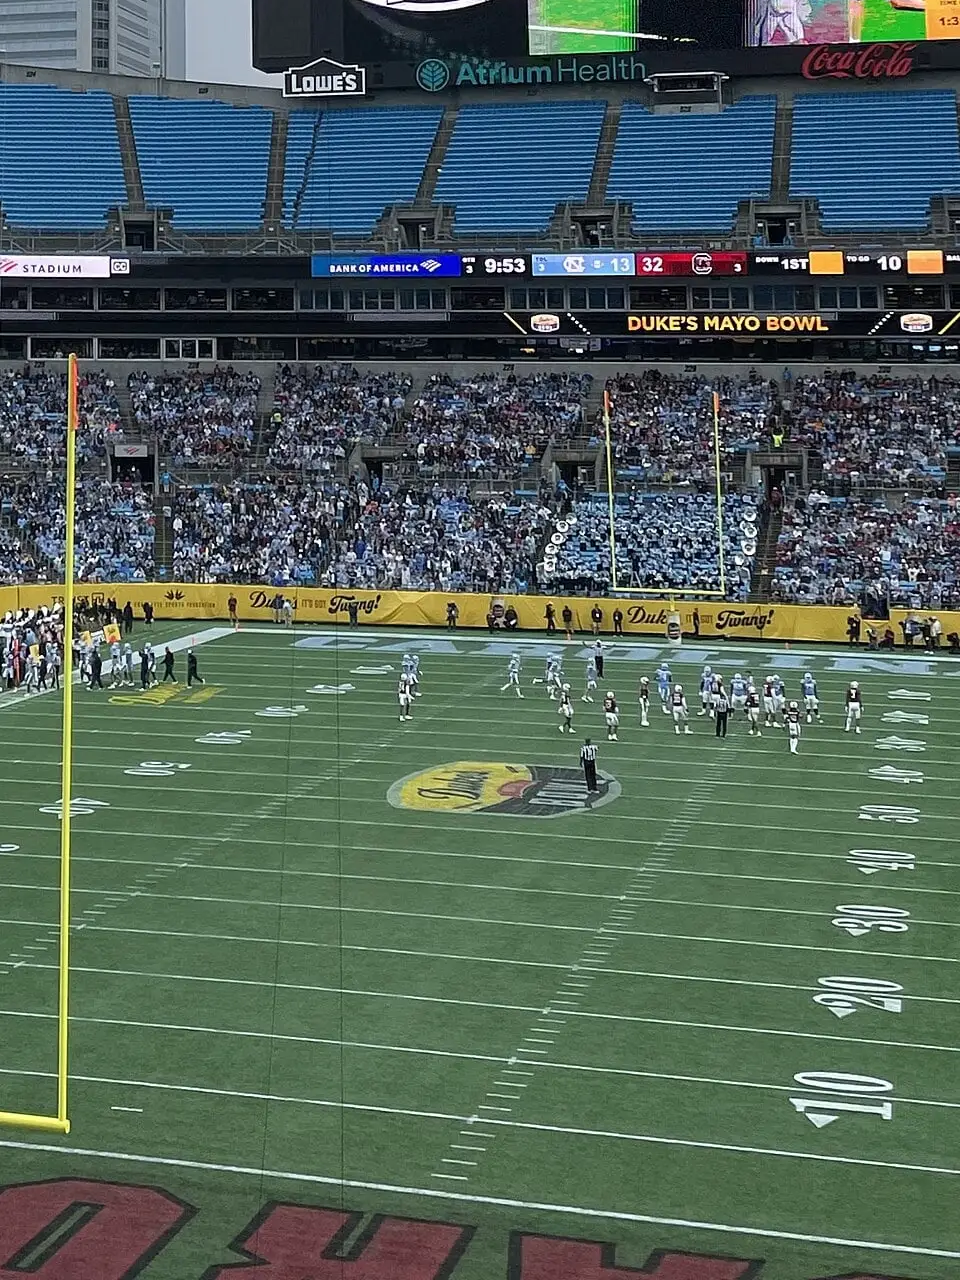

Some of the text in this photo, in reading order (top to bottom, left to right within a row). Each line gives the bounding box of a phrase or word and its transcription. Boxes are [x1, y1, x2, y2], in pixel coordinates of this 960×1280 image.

[455, 59, 646, 85] Atrium Health
[291, 71, 357, 93] LOWE'S
[23, 264, 82, 274] STADIUM
[113, 262, 128, 271] CC
[330, 264, 419, 273] BANK OF AMERICA
[466, 265, 474, 274] 3
[484, 258, 526, 274] 9:53
[610, 257, 630, 272] 13
[642, 257, 663, 272] 32
[734, 263, 742, 272] 3
[781, 258, 809, 270] 1ST
[877, 256, 901, 271] 10
[628, 316, 829, 331] DUKE'S MAYO BOWL
[249, 590, 298, 609] Du's
[716, 609, 775, 630] Twang!
[291, 636, 960, 677] CAROLIN
[858, 805, 921, 824] 50
[846, 849, 916, 870] 40
[831, 904, 910, 933] 30
[812, 975, 904, 1013] 20
[789, 1070, 894, 1120] 10
